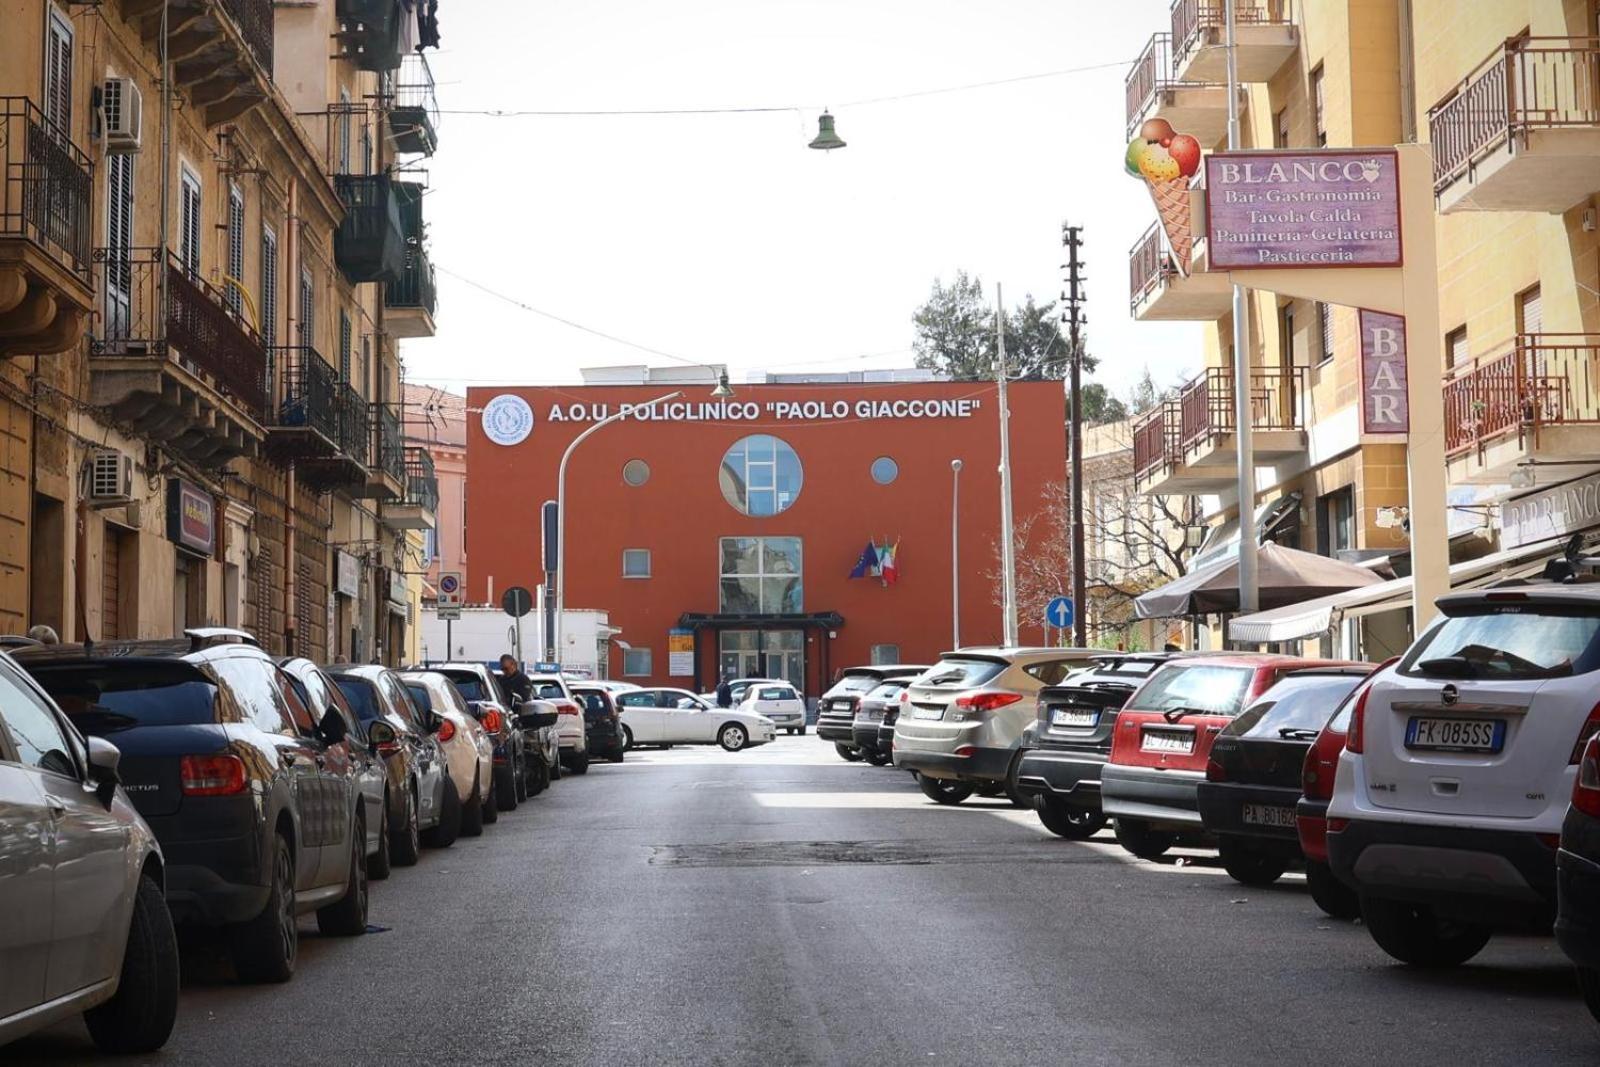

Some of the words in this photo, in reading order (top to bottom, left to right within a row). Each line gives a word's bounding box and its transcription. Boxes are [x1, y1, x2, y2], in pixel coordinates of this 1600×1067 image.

[1220, 161, 1365, 184] BLANCO
[1246, 210, 1304, 224] Tavola
[1309, 209, 1362, 223] Calda
[1258, 247, 1353, 263] Pasticceria
[1370, 327, 1402, 424] BAR
[620, 402, 759, 421] POLICLINICO
[766, 400, 849, 419] "PAOLO
[855, 399, 980, 418] GIACCONE"
